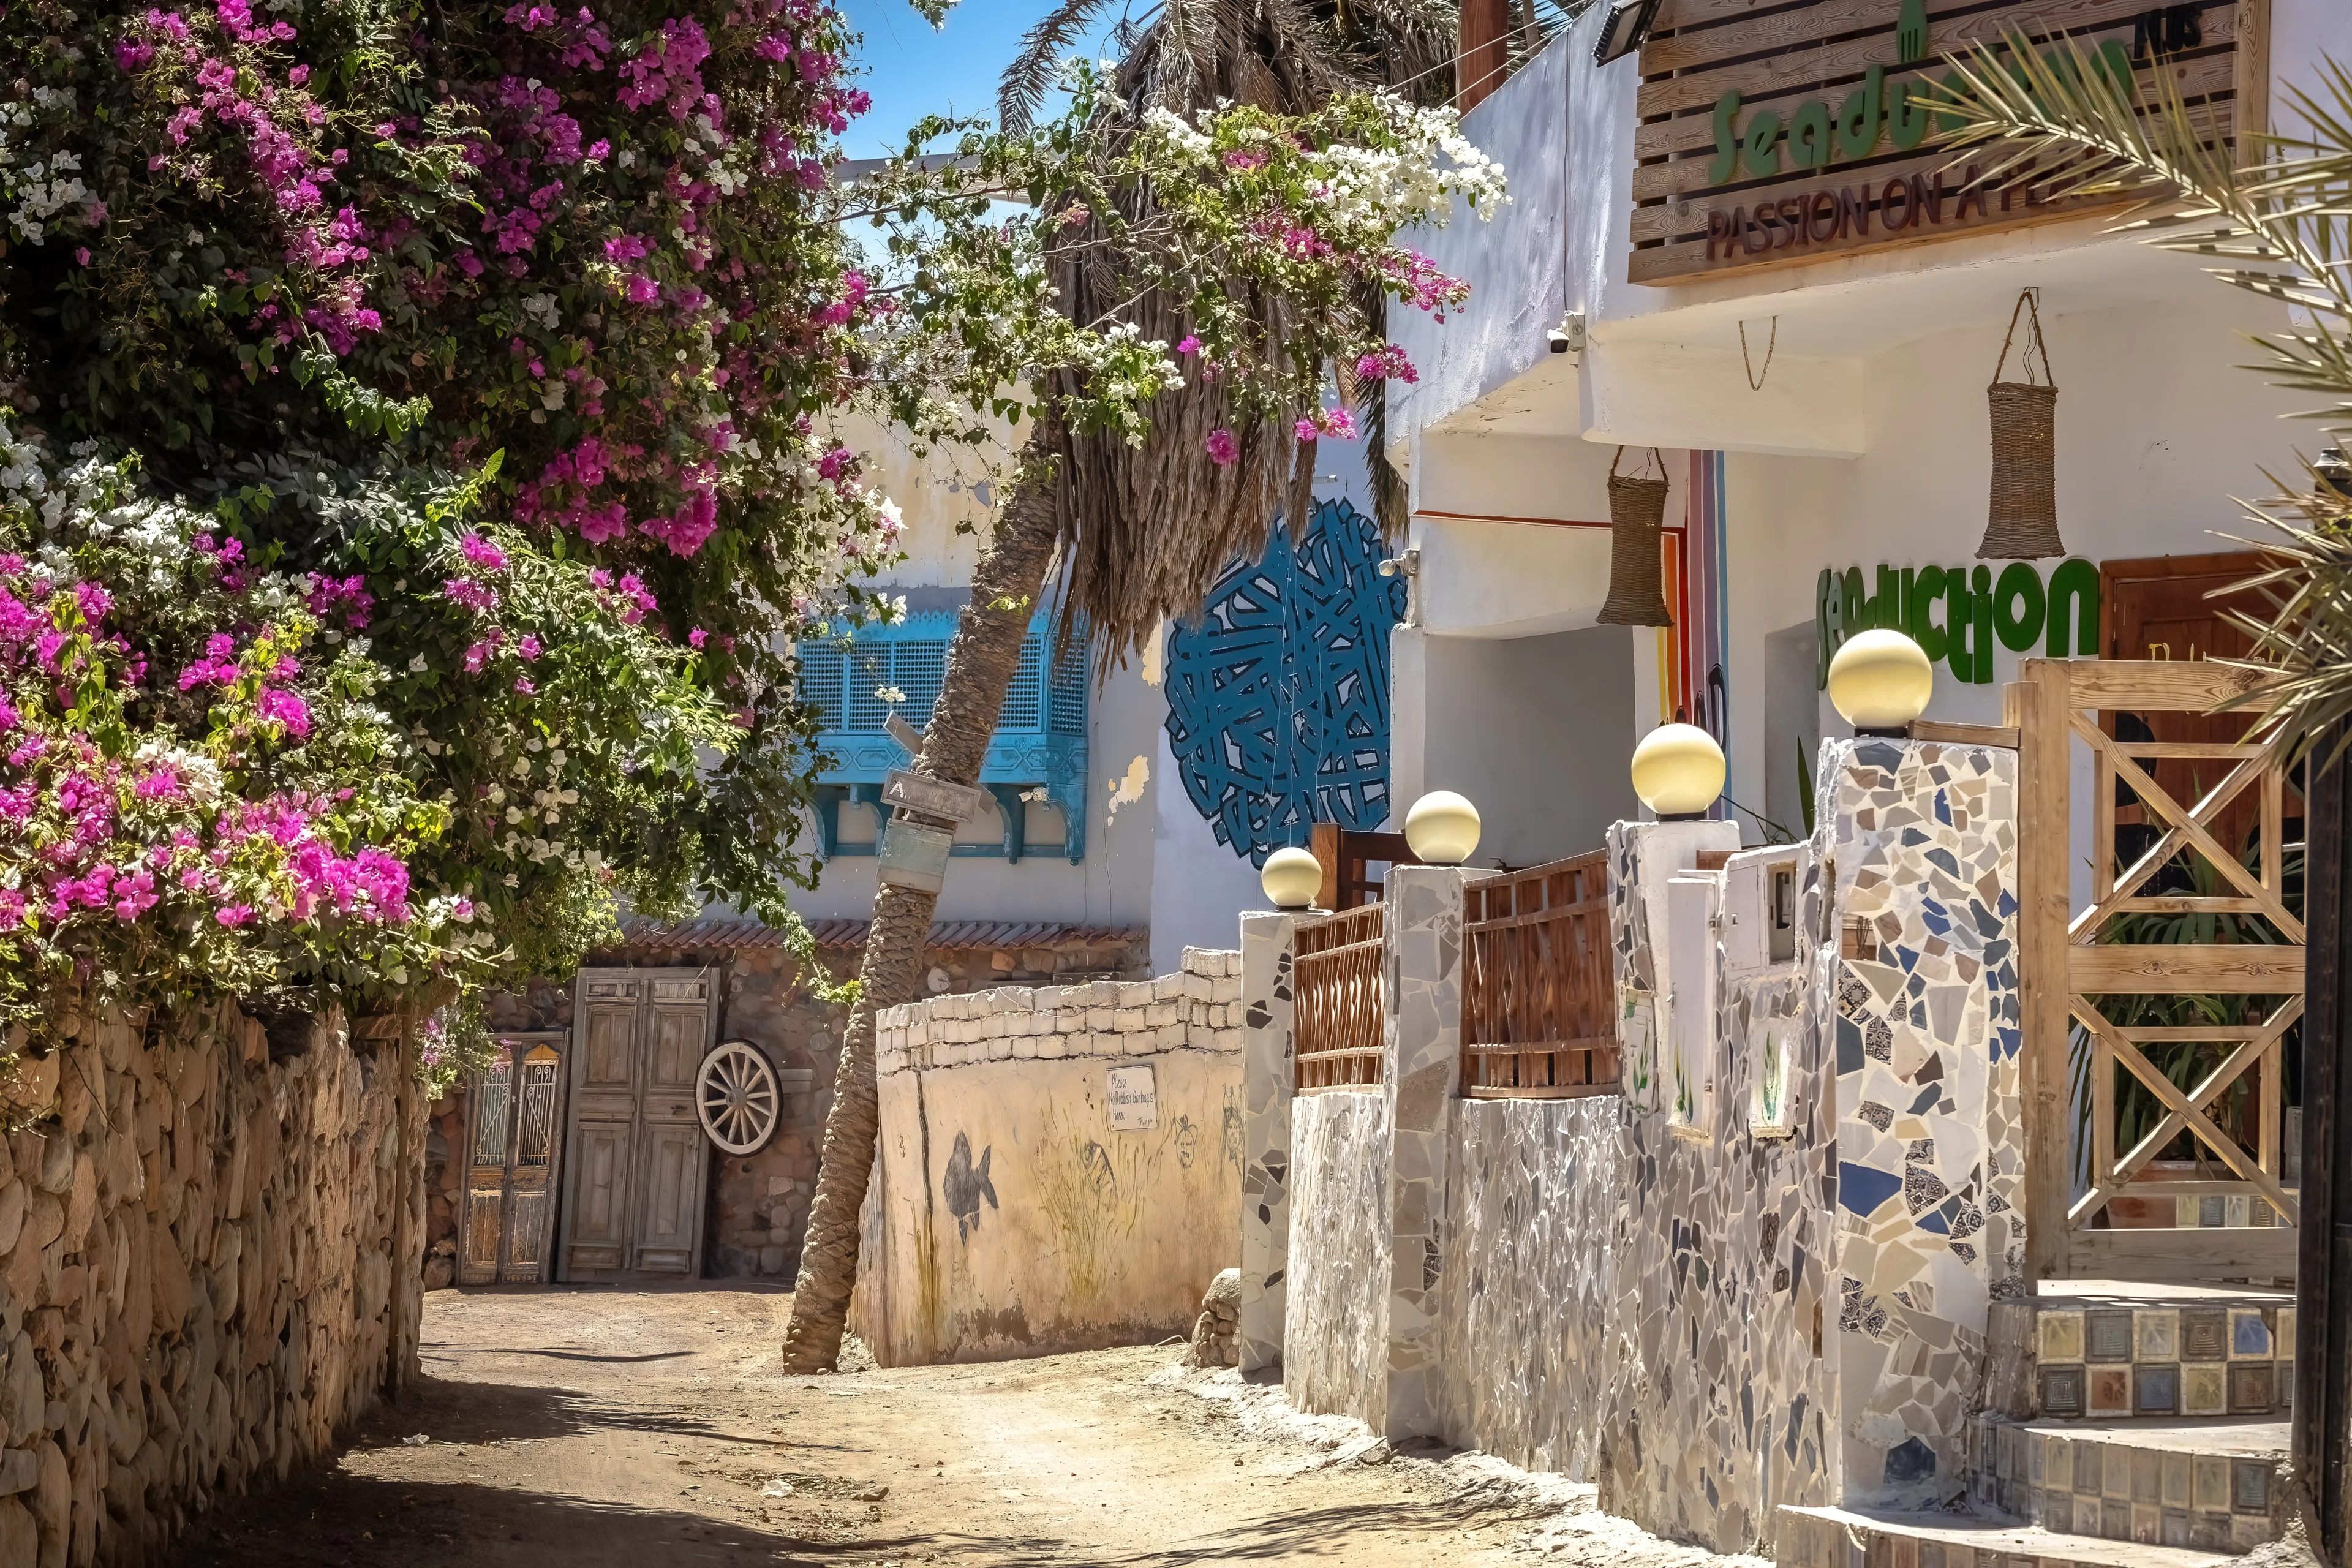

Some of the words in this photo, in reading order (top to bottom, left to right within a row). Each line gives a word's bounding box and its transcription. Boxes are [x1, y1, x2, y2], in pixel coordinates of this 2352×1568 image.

[1706, 184, 1870, 261] PASSION
[1880, 172, 1943, 230] ON
[1954, 164, 1988, 219] A
[2000, 144, 2100, 212] PLA
[1109, 1091, 1115, 1106] No
